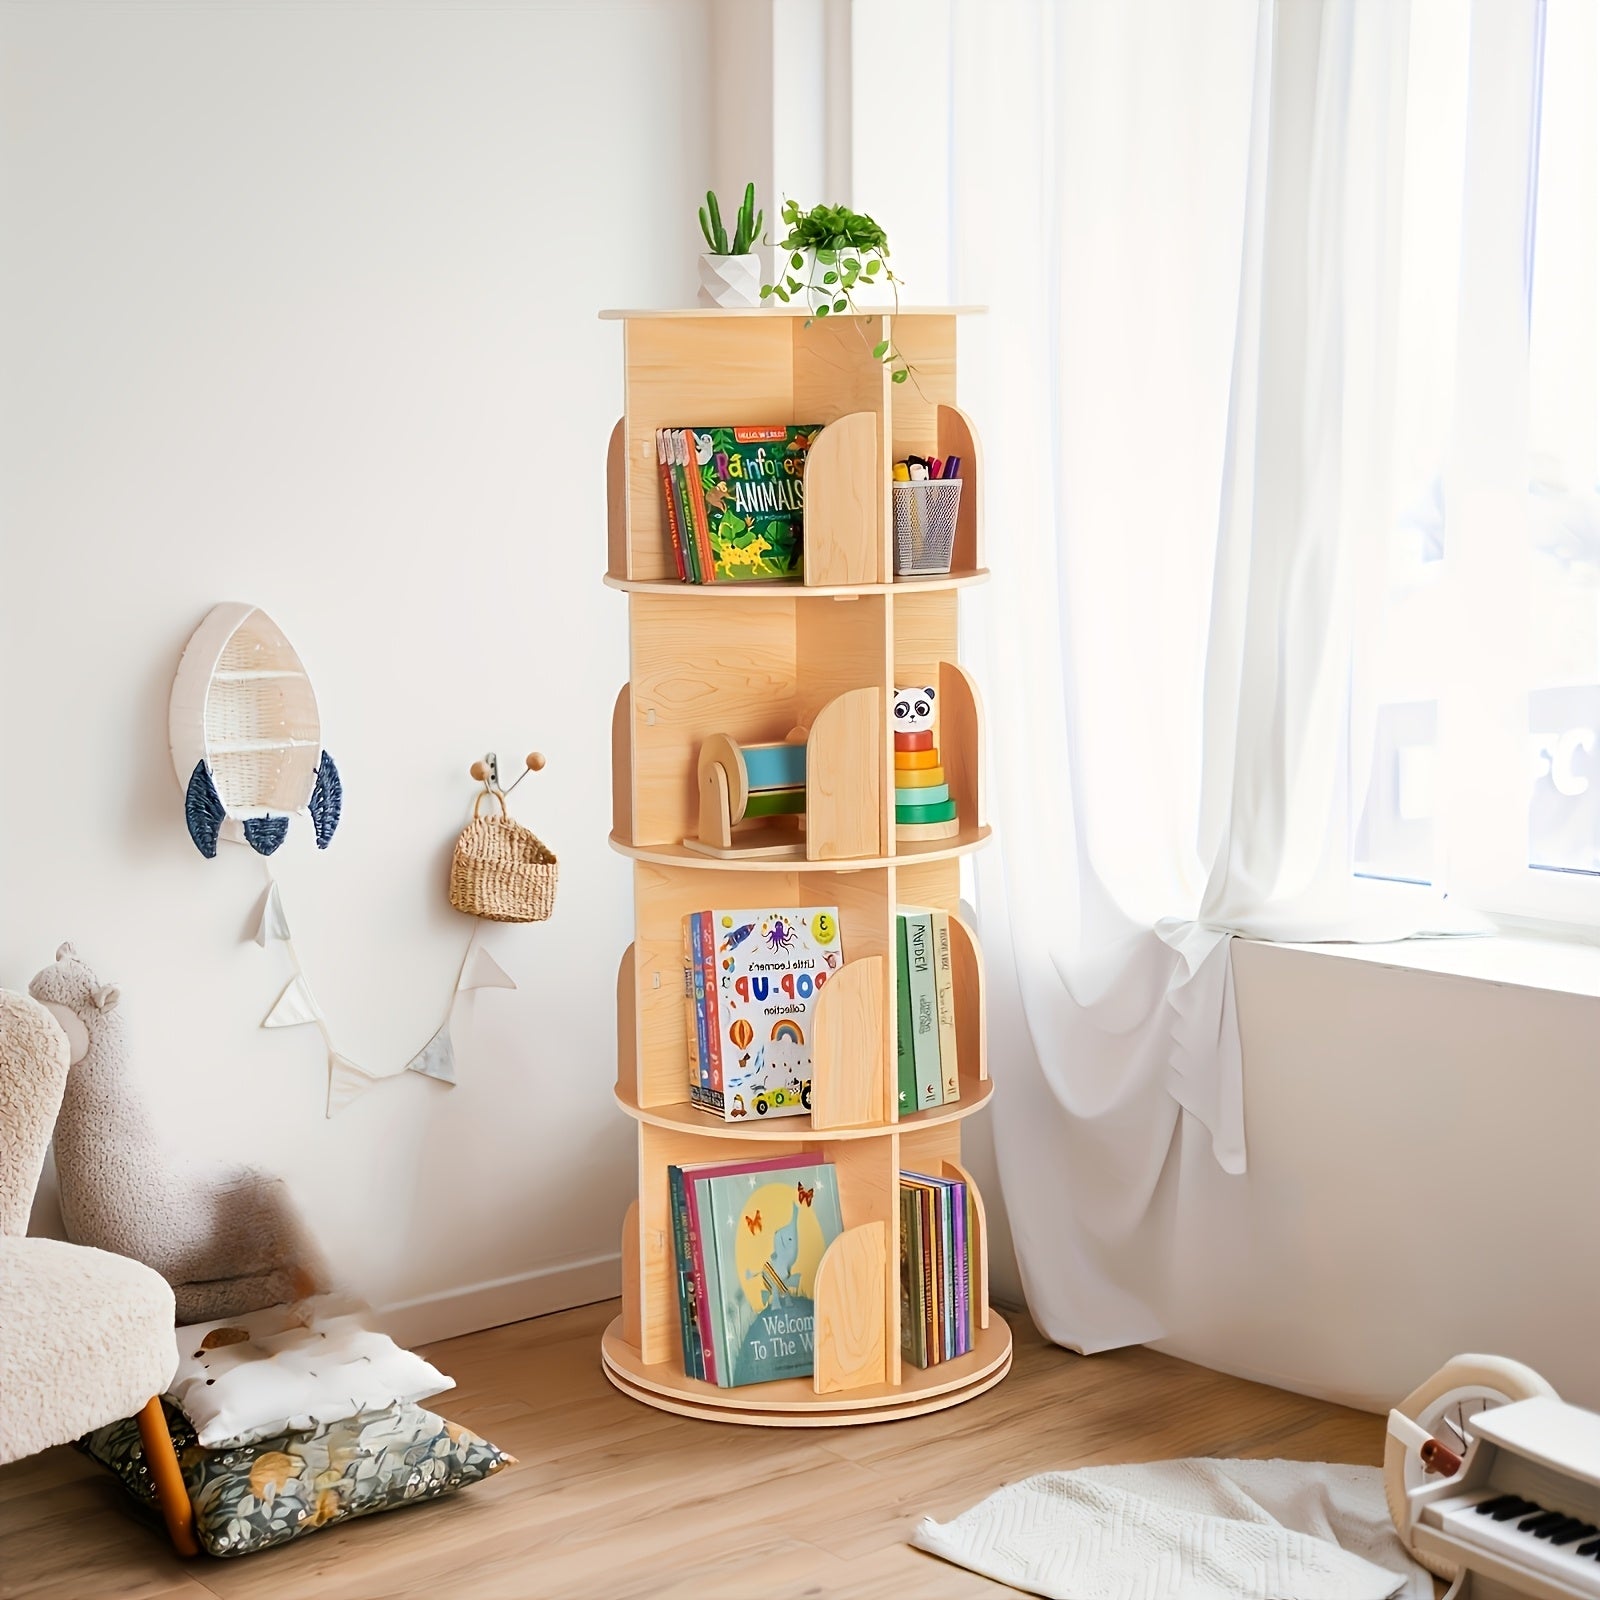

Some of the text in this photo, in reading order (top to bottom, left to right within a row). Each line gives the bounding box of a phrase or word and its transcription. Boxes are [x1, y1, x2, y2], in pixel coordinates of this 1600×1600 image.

[735, 479, 804, 513] ANIMALS
[762, 1314, 815, 1336] Welcom
[750, 1340, 767, 1361] To
[770, 1337, 797, 1358] The
